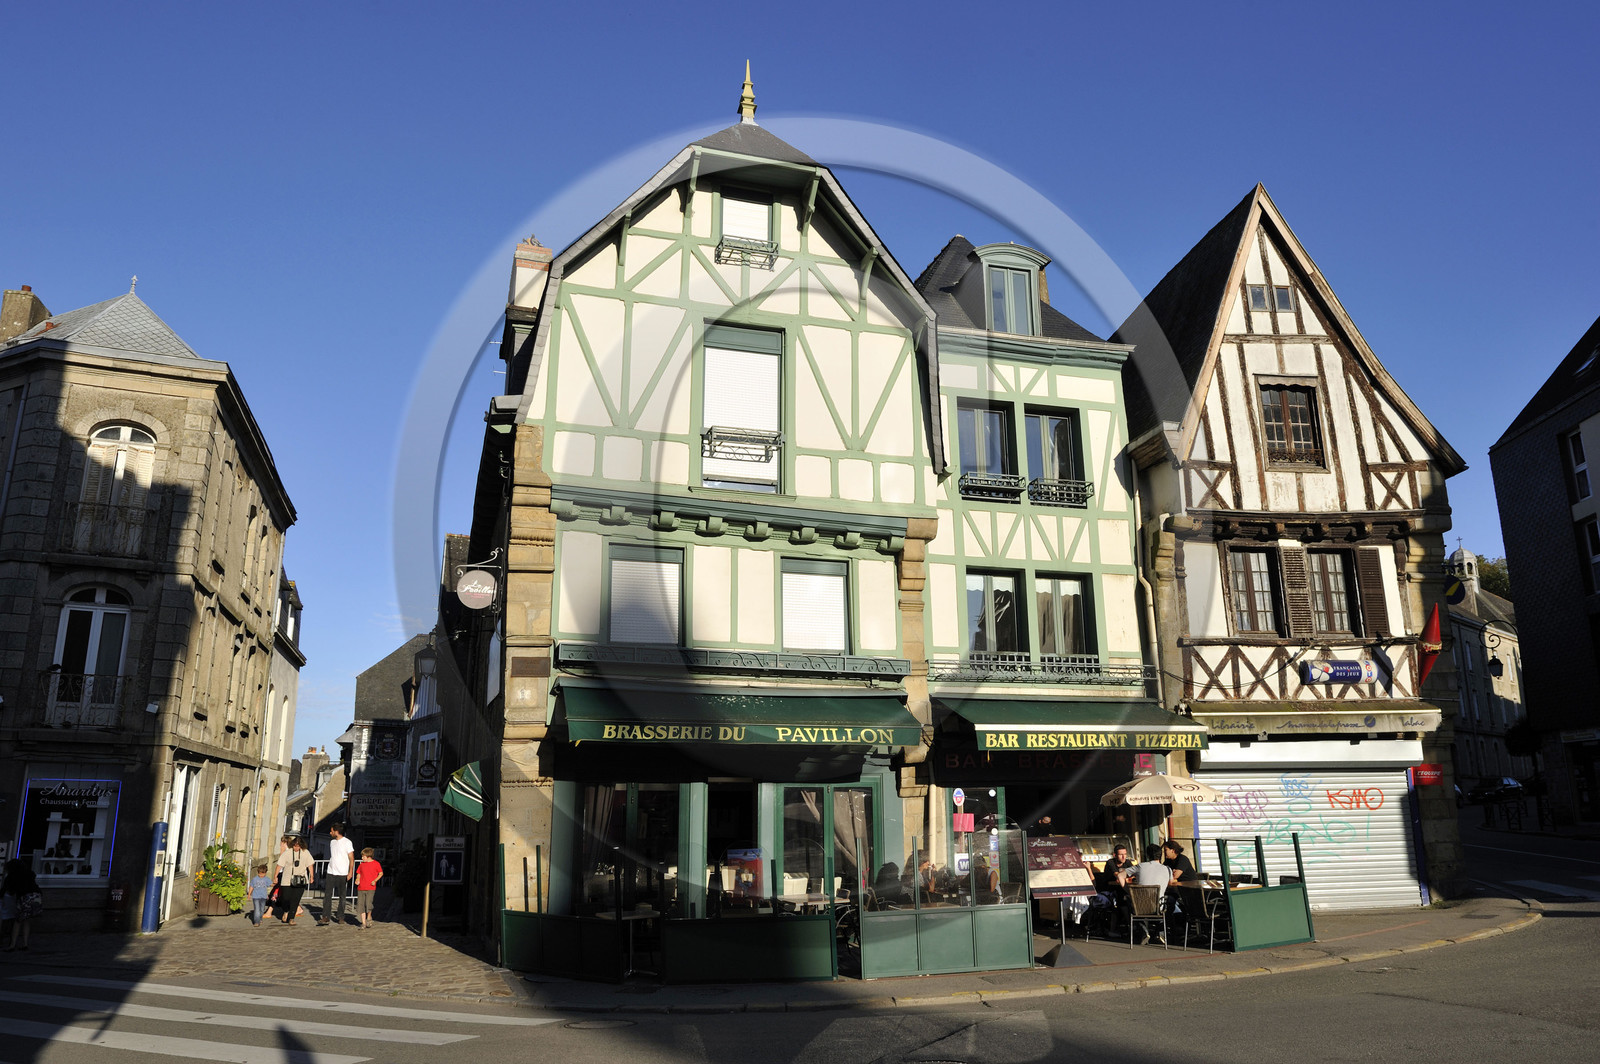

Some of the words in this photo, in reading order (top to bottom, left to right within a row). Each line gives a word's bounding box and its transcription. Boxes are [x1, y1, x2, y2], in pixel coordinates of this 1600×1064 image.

[1399, 716, 1425, 727] Tabac
[602, 724, 713, 740] BRASSERIE
[718, 726, 746, 741] DU
[775, 727, 894, 744] PAVILLON
[985, 733, 1020, 748] BAR
[1026, 733, 1127, 748] RESTAURANT
[1135, 733, 1201, 748] PIZZERIA
[945, 753, 994, 769] BAR
[1184, 795, 1204, 803] MIKO
